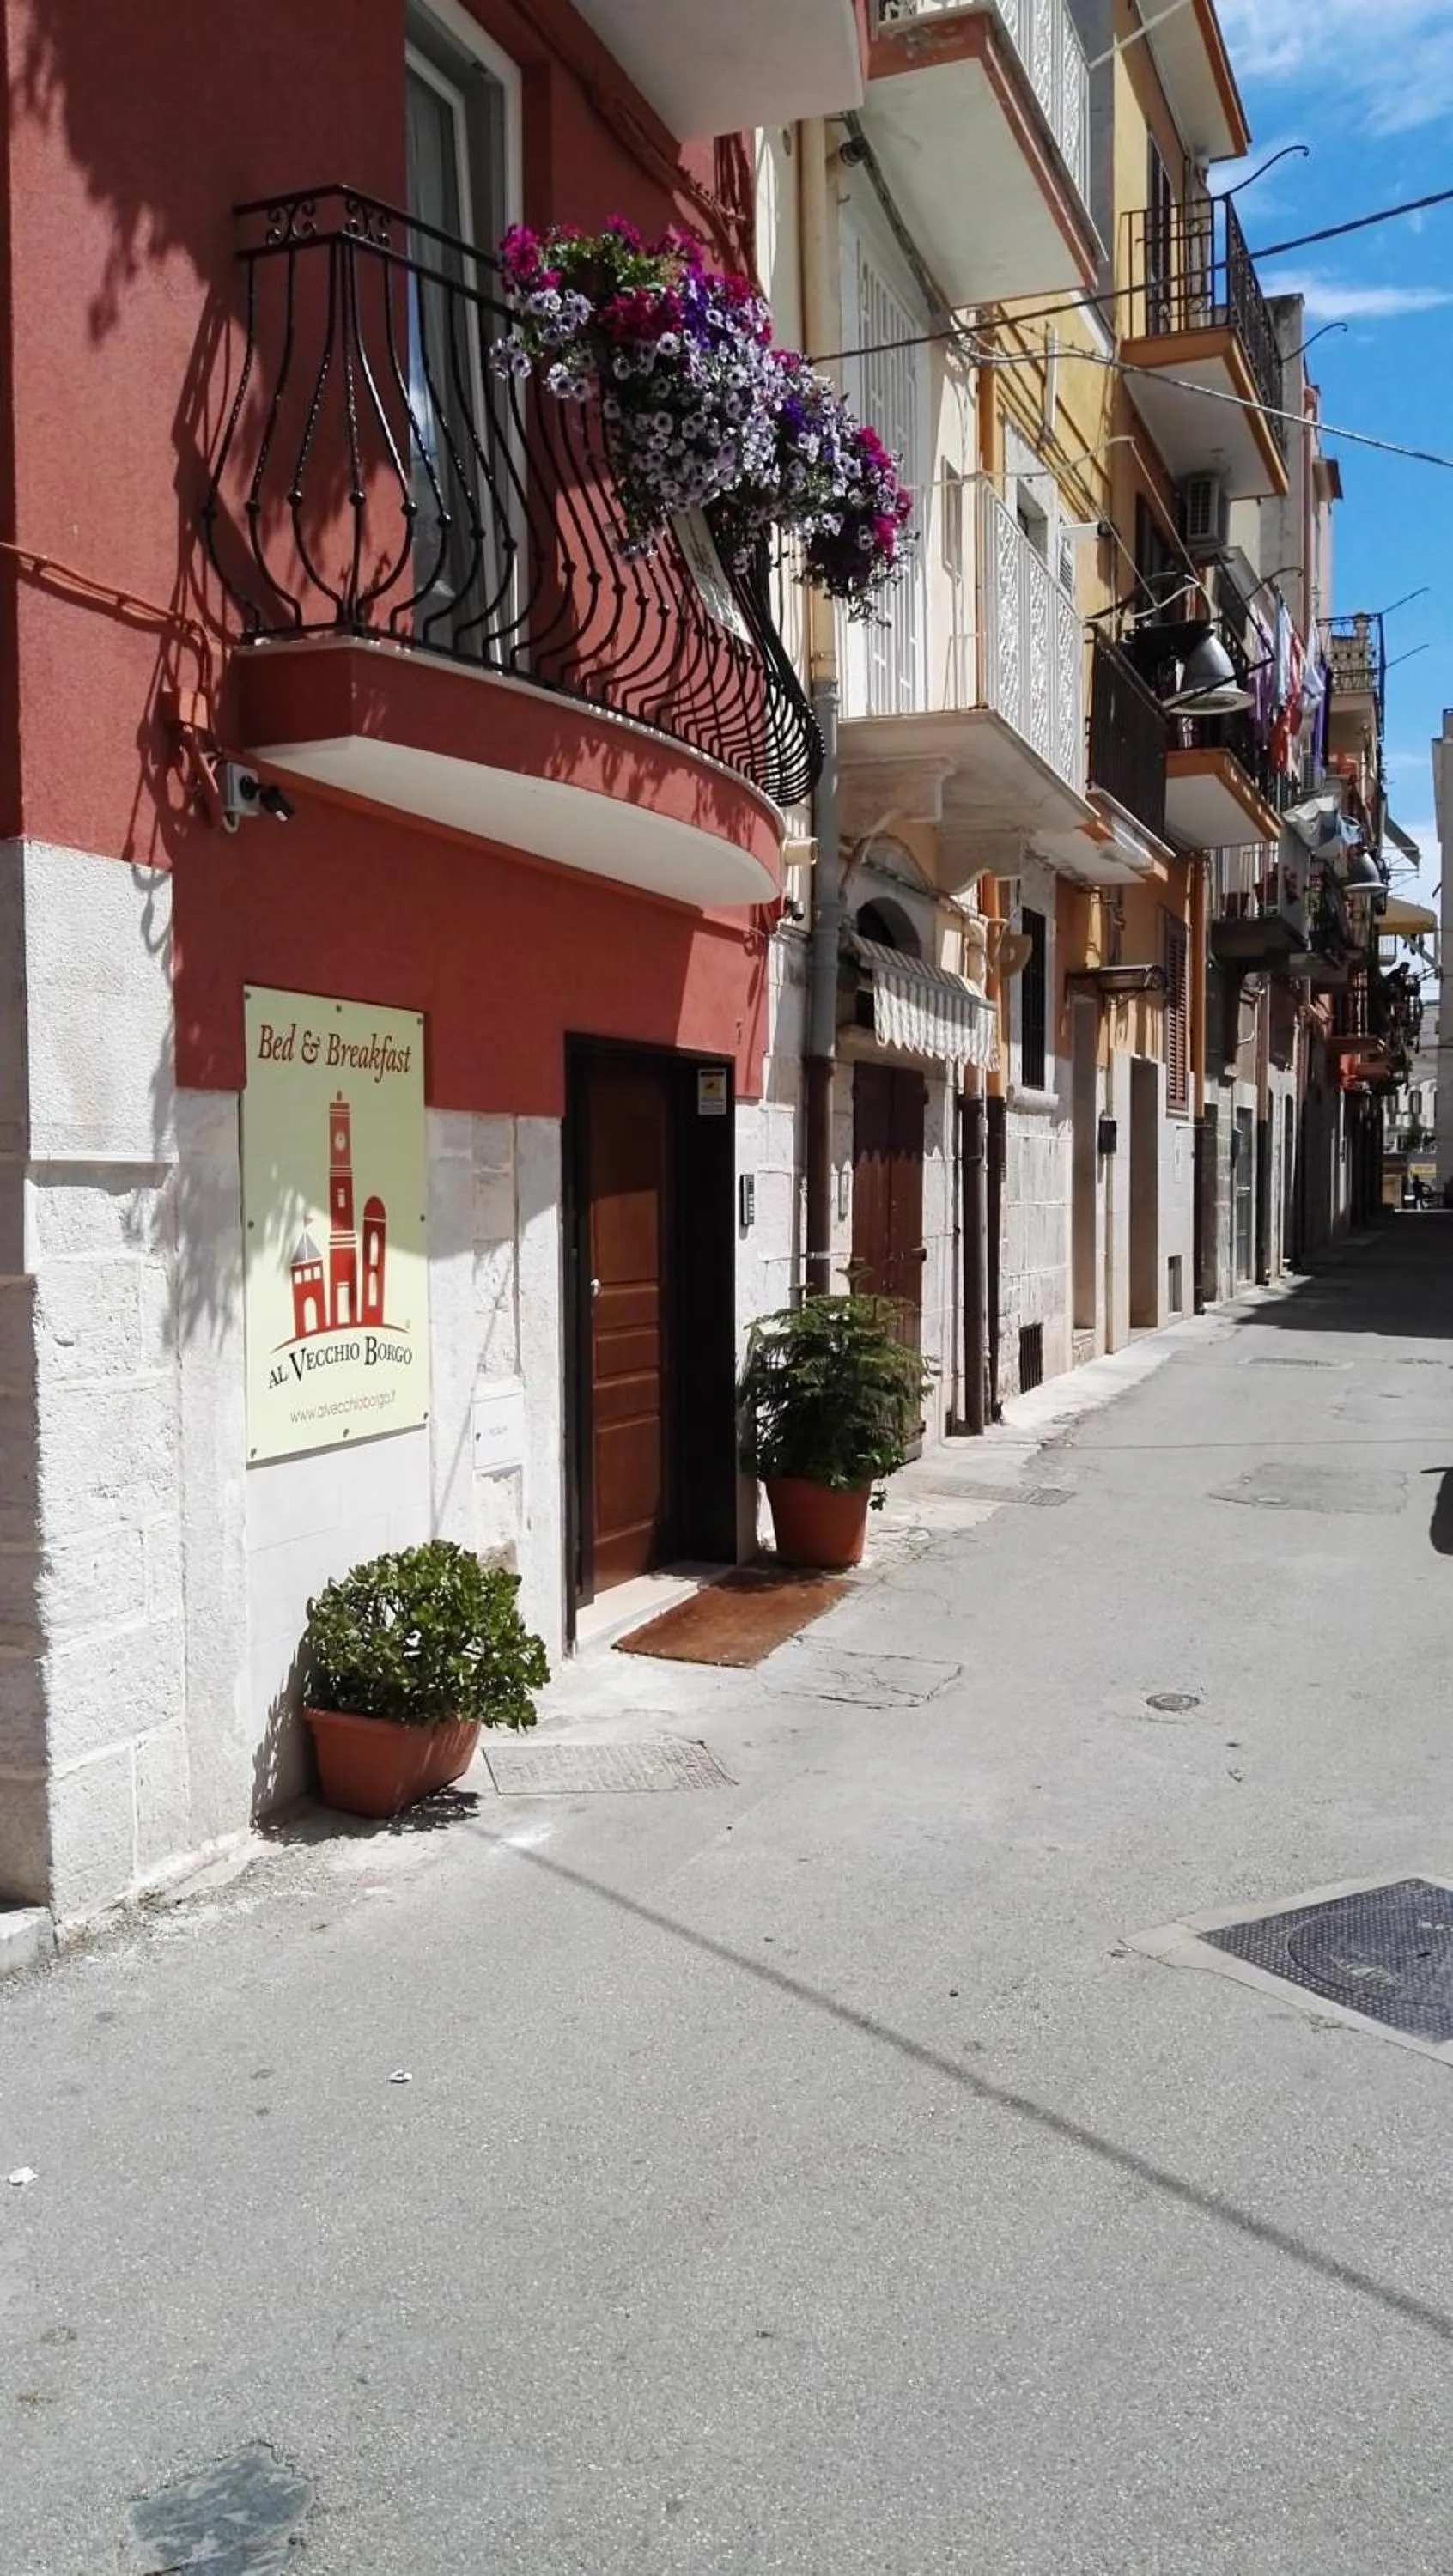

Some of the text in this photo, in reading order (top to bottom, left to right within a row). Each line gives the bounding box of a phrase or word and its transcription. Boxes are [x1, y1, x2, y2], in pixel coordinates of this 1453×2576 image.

[258, 1023, 412, 1084] Bed & Breakfast
[268, 1335, 413, 1389] AL VECCHIO BORGO
